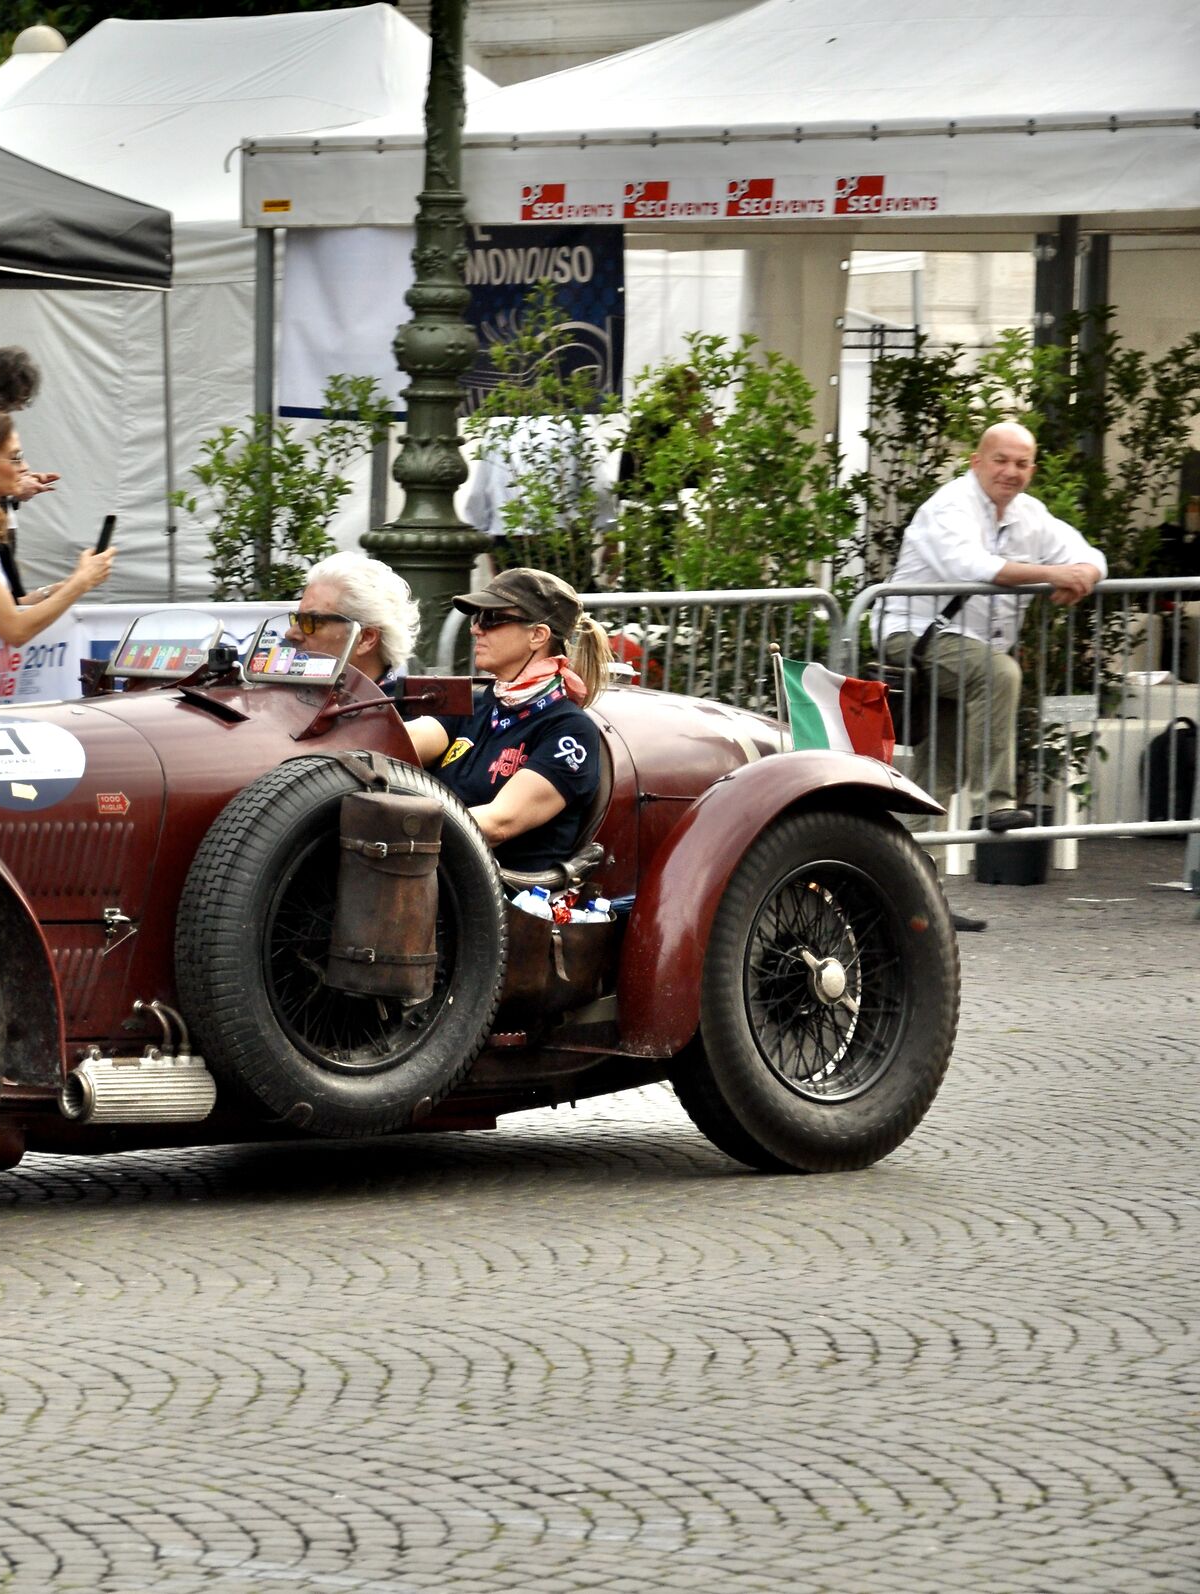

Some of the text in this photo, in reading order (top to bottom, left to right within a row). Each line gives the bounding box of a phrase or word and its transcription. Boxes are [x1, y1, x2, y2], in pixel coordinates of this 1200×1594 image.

[532, 202, 614, 218] SEC EVENTS
[634, 201, 719, 217] SEC EVENTS
[738, 198, 825, 215] SEC EVENTS
[846, 195, 939, 212] SEC EVENTS
[23, 641, 69, 670] 2017
